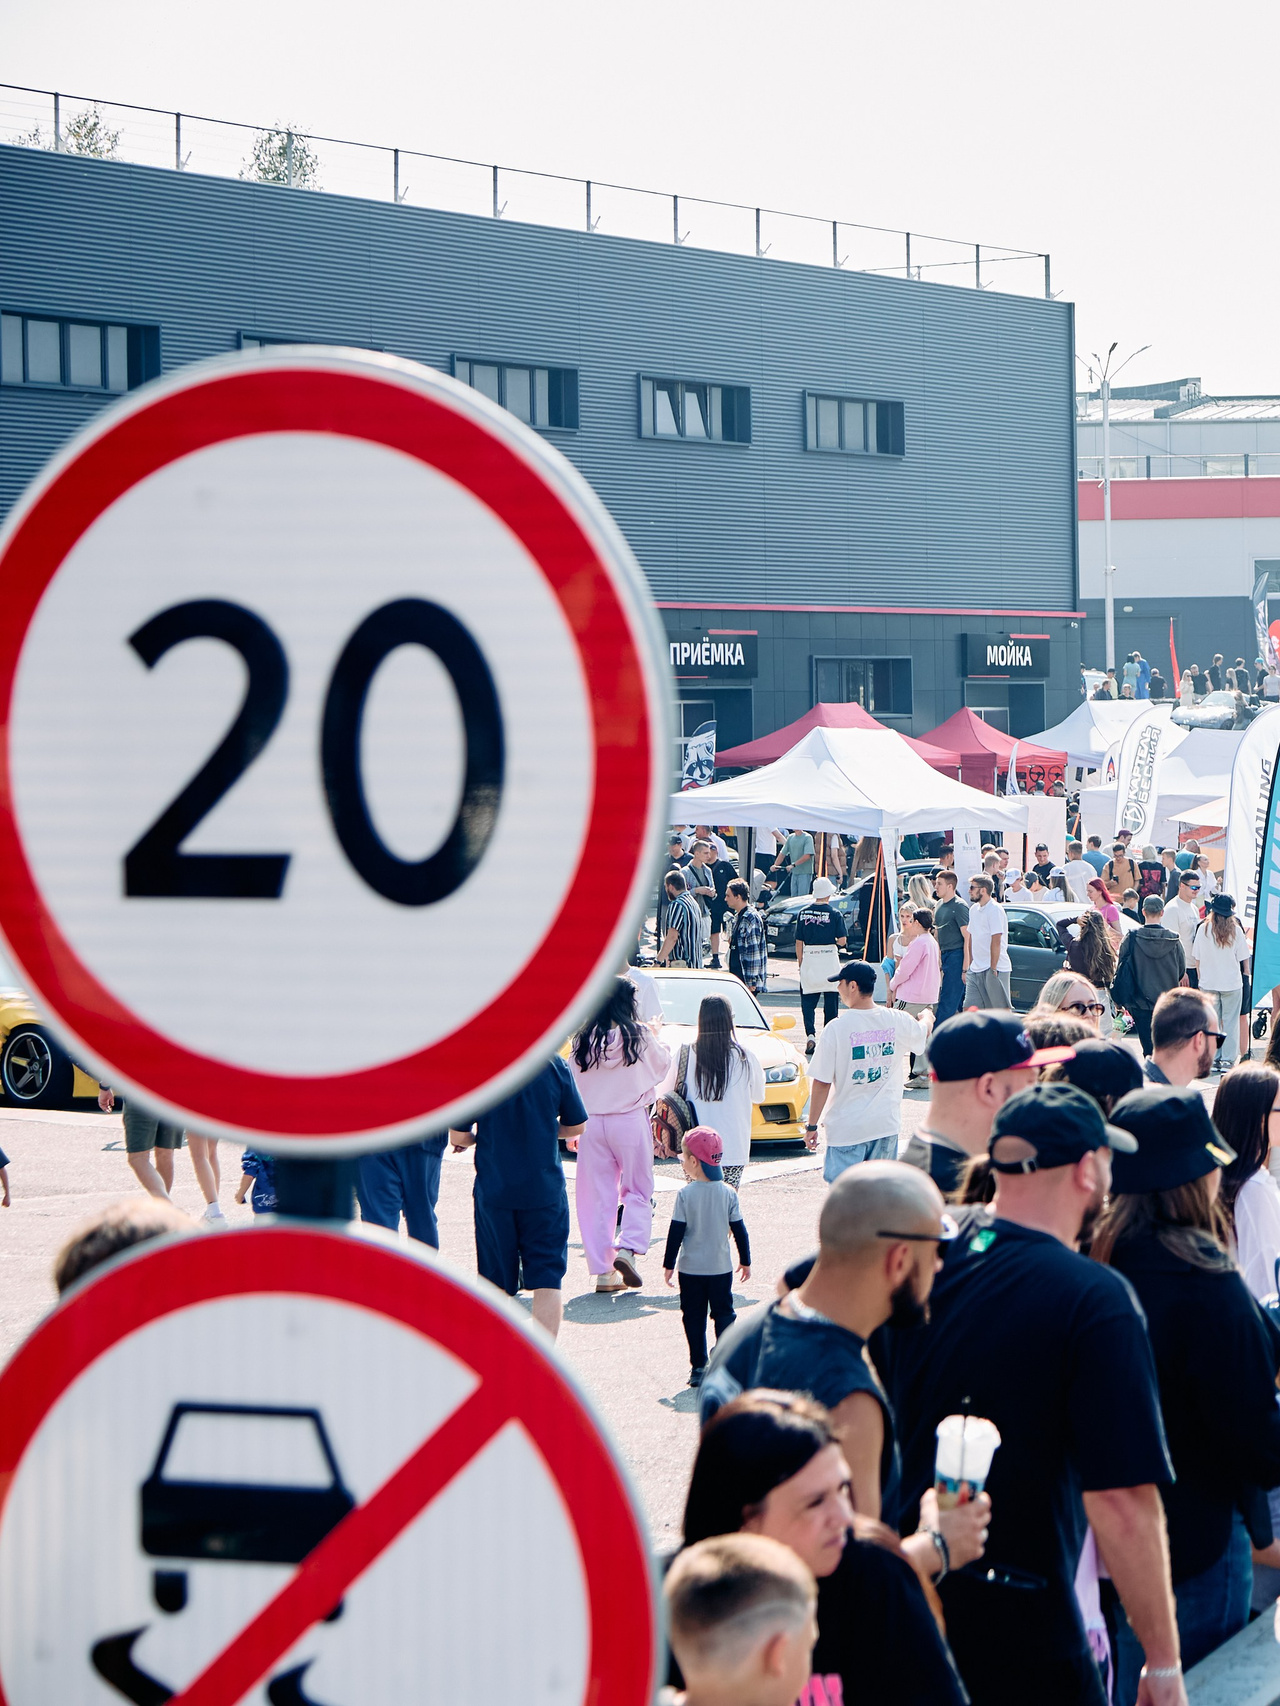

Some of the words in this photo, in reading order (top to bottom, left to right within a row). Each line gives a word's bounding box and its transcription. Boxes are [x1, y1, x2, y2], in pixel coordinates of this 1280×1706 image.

[669, 636, 745, 666] ПРИЁМКА
[986, 639, 1033, 667] МОЙКА
[123, 596, 507, 907] 20
[1128, 725, 1152, 800] КАРТЕЛЬ
[1138, 727, 1161, 803] БЕСТИЯ
